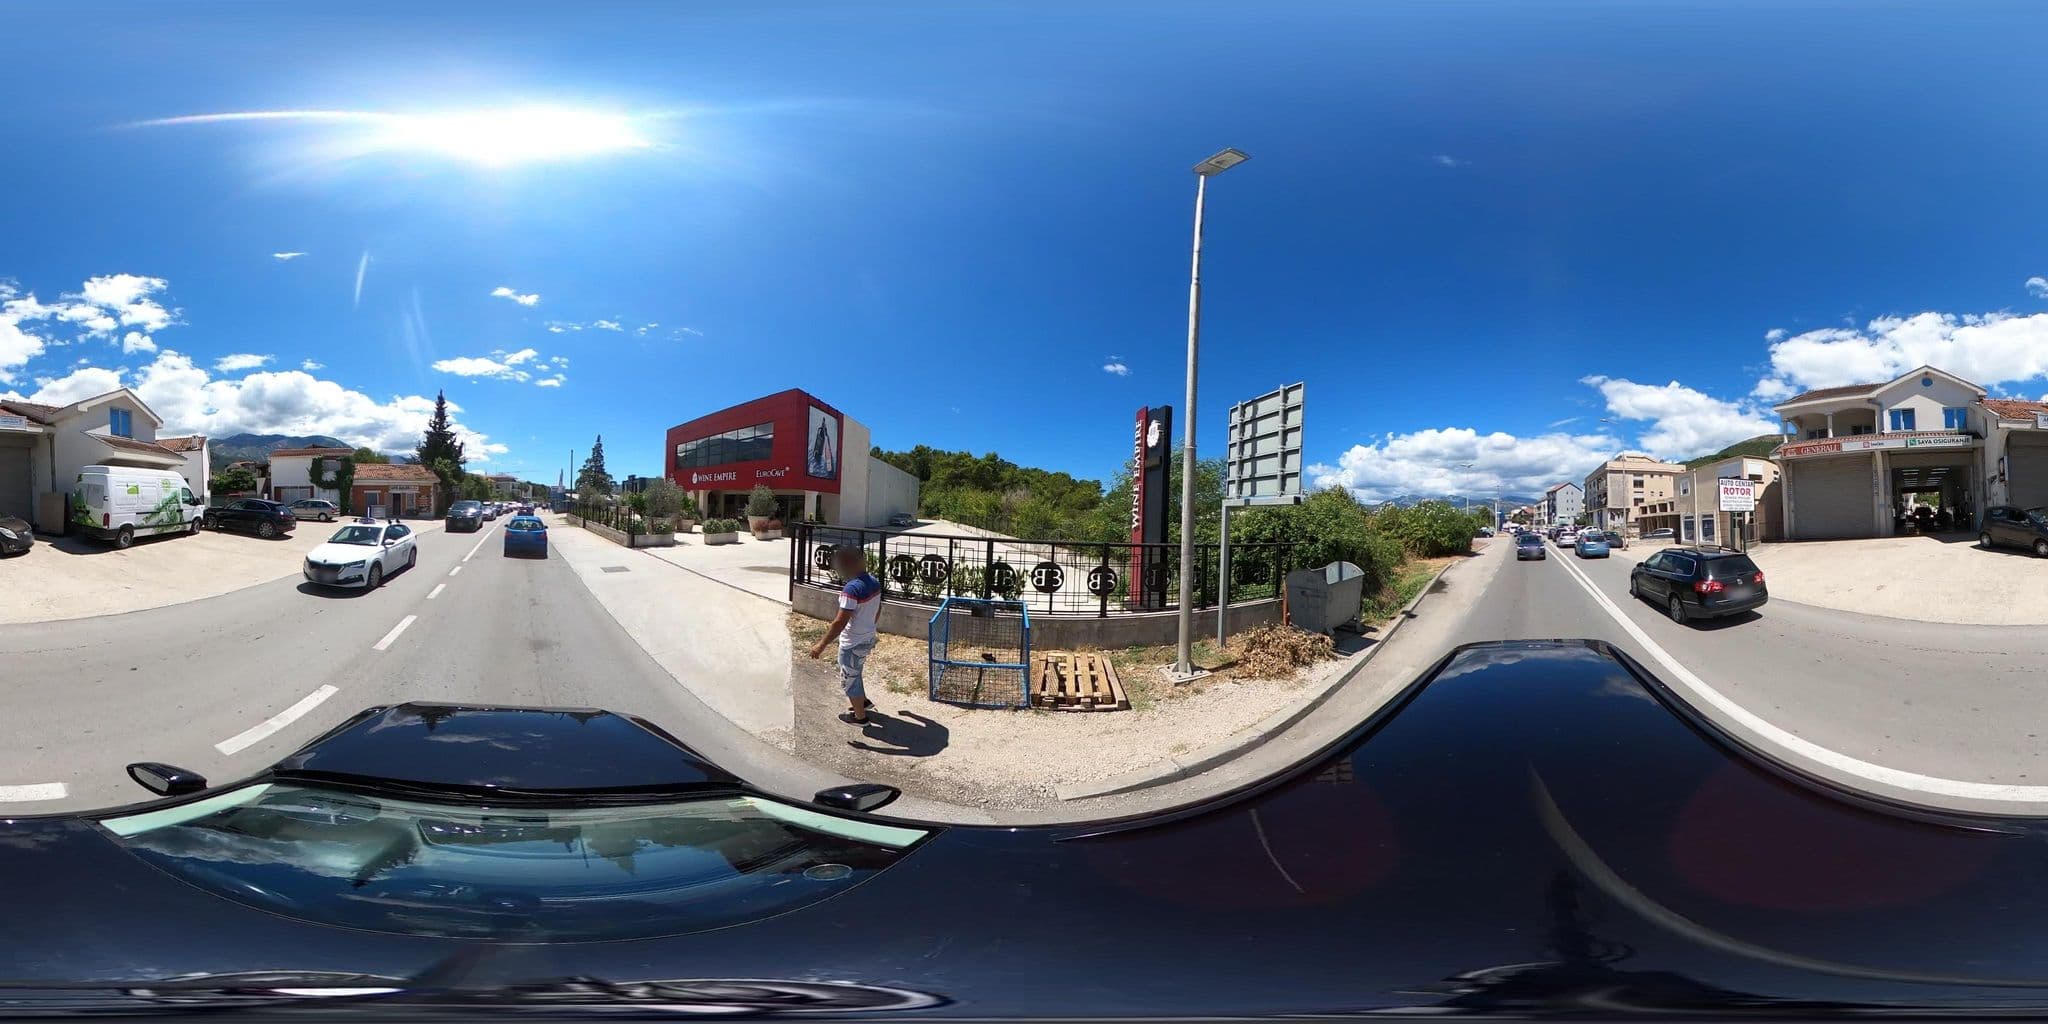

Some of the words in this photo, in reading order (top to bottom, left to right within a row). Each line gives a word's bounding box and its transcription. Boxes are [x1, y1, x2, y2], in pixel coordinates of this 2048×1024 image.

[1133, 420, 1142, 478] EMPIRE
[697, 473, 713, 482] WINE
[713, 471, 737, 481] EMPIRE
[1723, 487, 1751, 496] ROTOR
[1132, 484, 1140, 529] WINE
